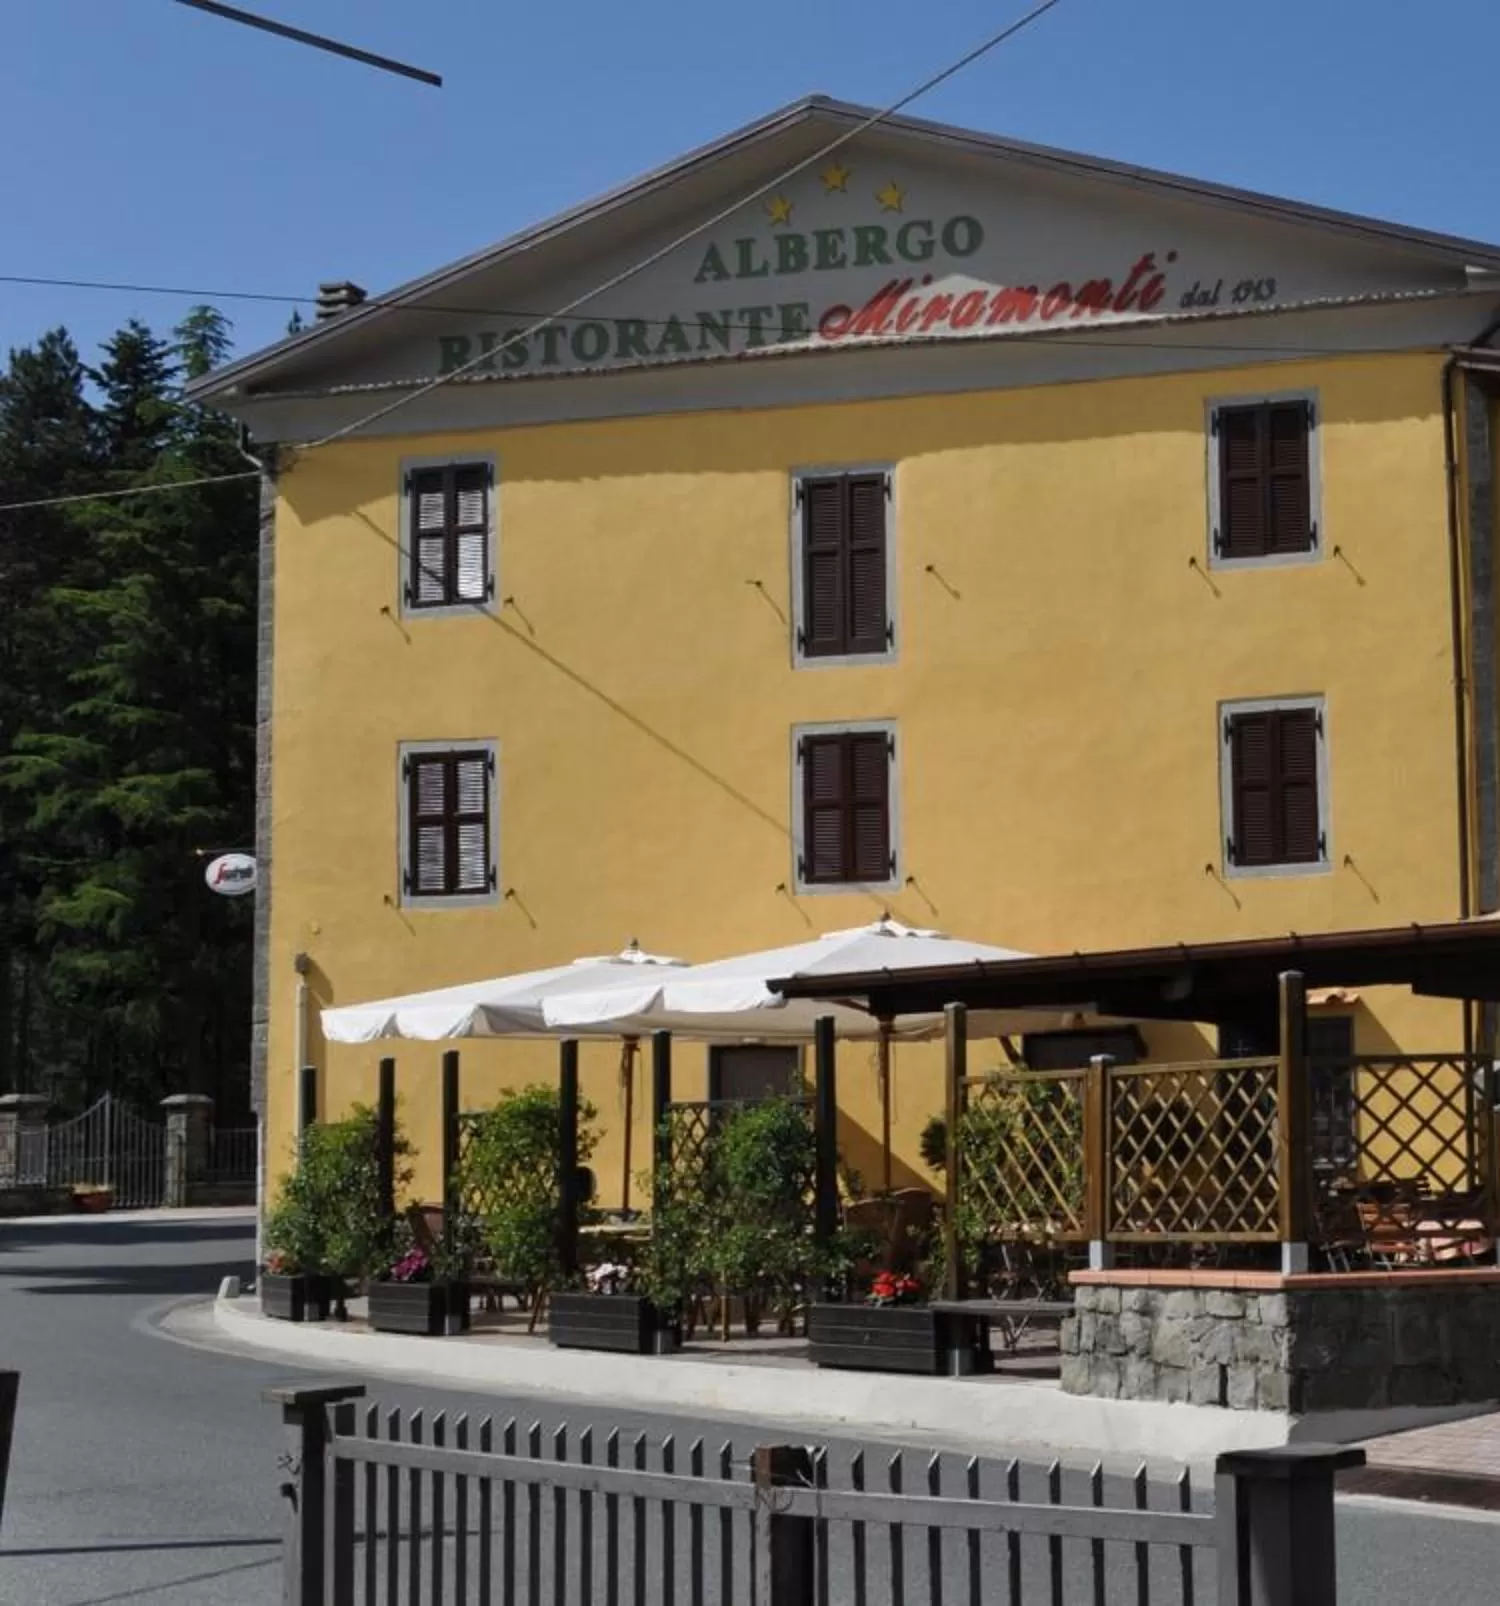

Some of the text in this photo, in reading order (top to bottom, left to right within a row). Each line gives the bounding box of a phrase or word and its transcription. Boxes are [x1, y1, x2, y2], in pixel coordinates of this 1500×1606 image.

[692, 214, 985, 284] ALBERGO
[437, 302, 812, 376] RISTORANTE
[818, 250, 1178, 342] Miramonti
[1178, 278, 1222, 309] dal
